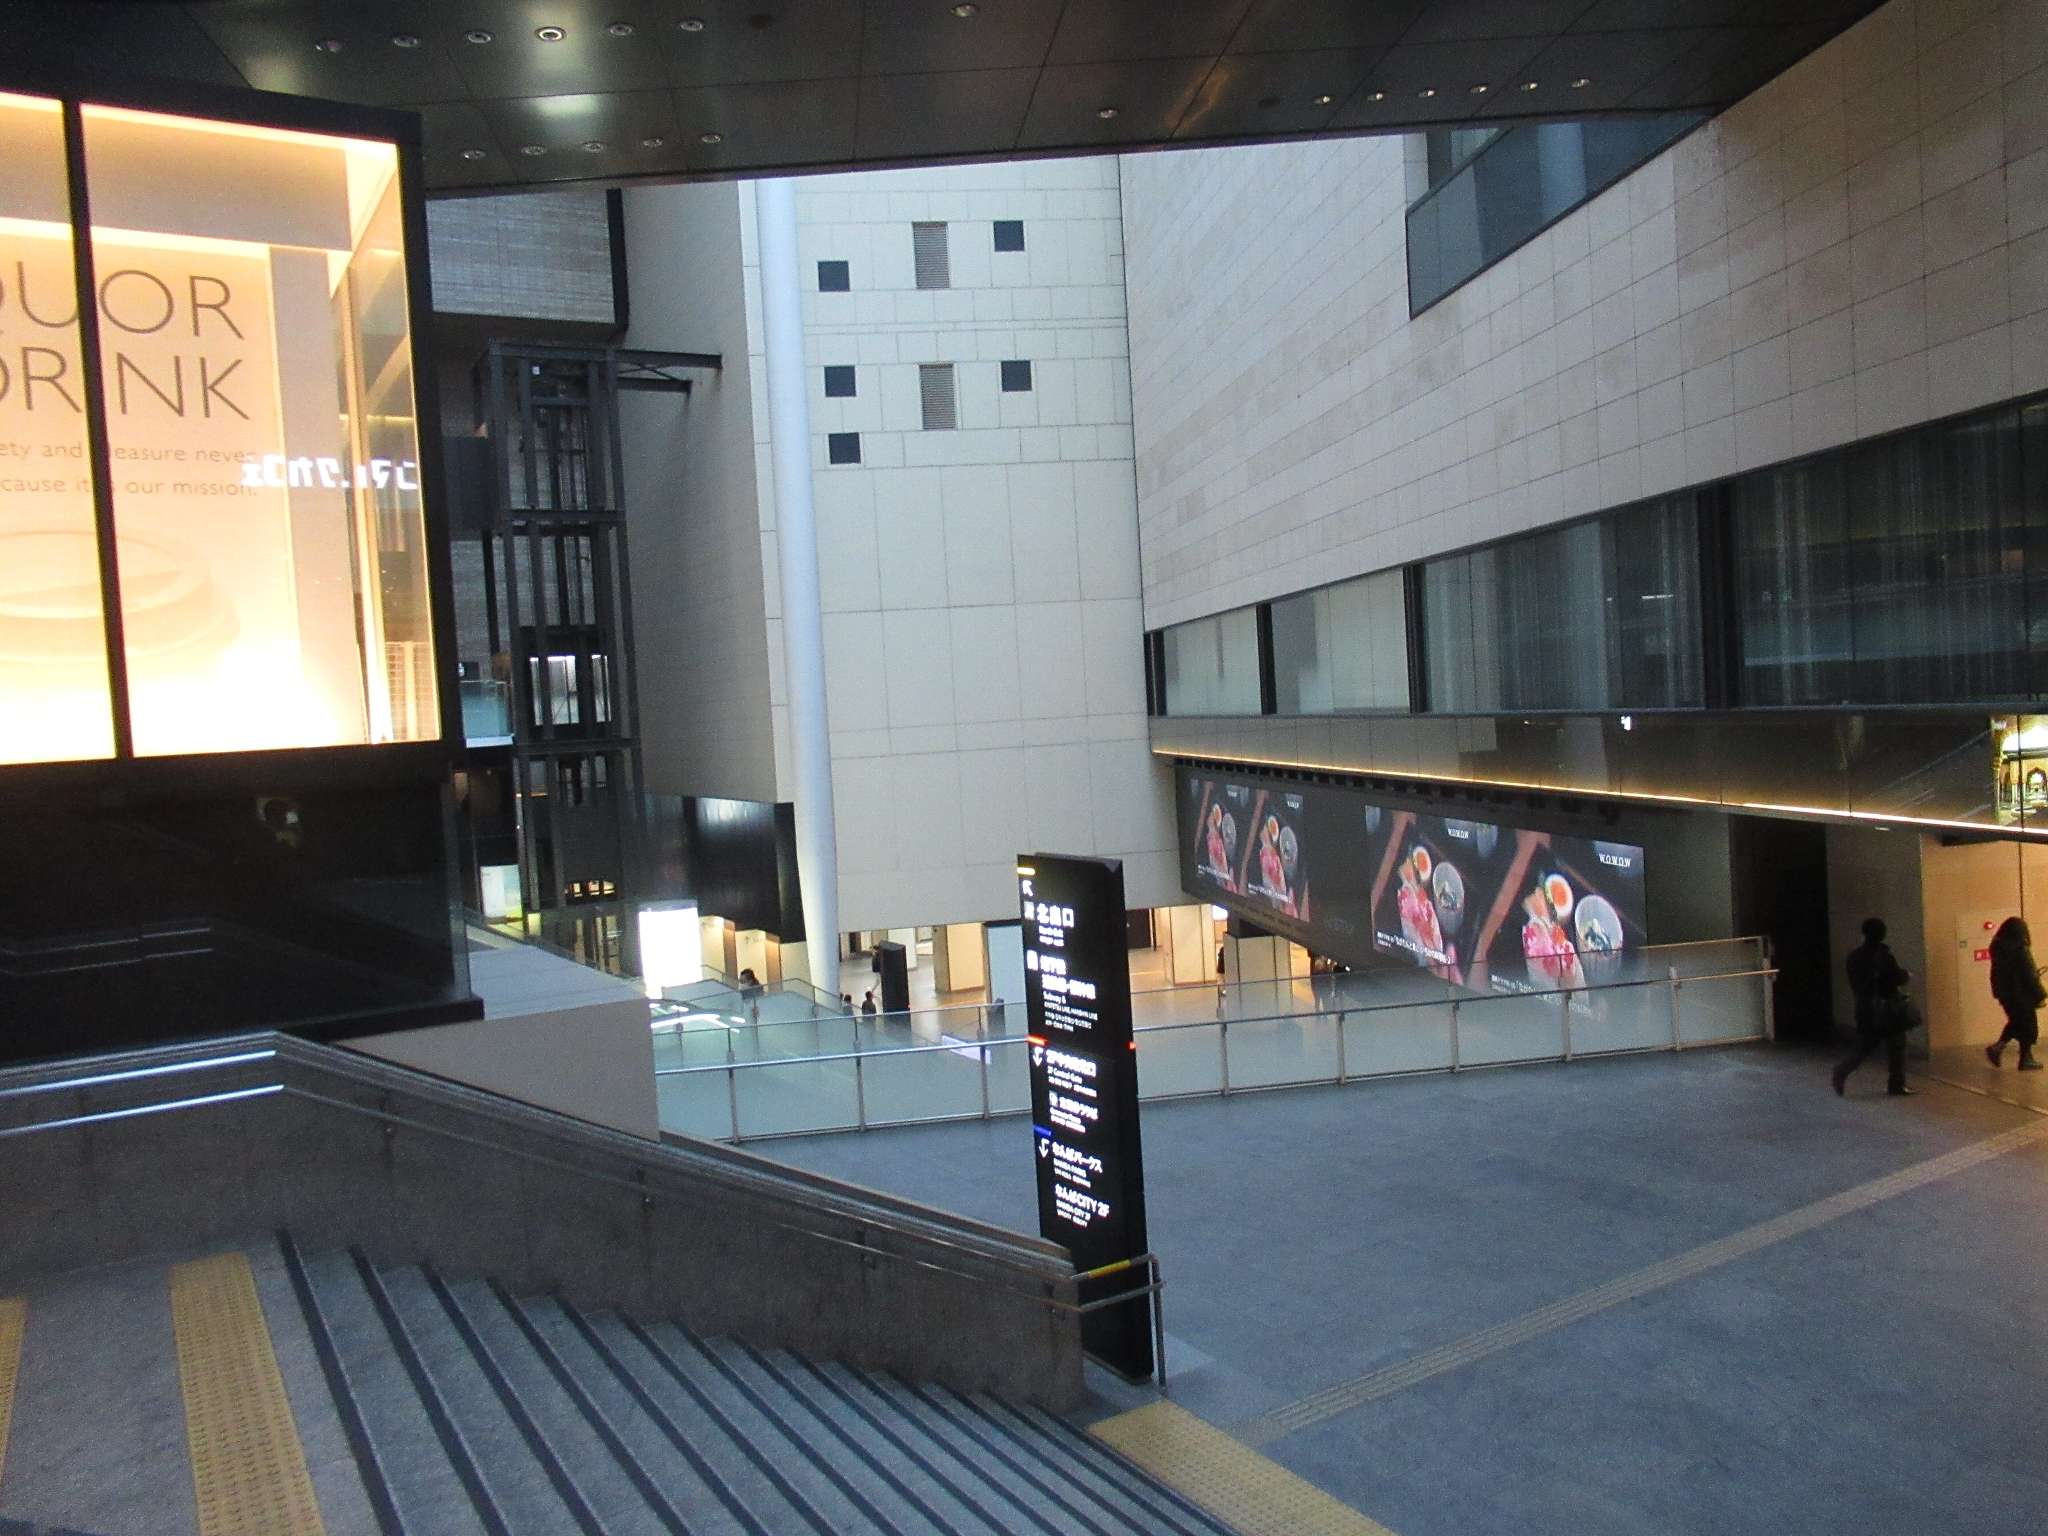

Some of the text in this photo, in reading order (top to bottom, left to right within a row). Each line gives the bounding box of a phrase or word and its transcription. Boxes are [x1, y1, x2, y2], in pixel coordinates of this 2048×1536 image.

[0, 261, 245, 341] UOR
[42, 441, 83, 459] and
[126, 481, 162, 495] our
